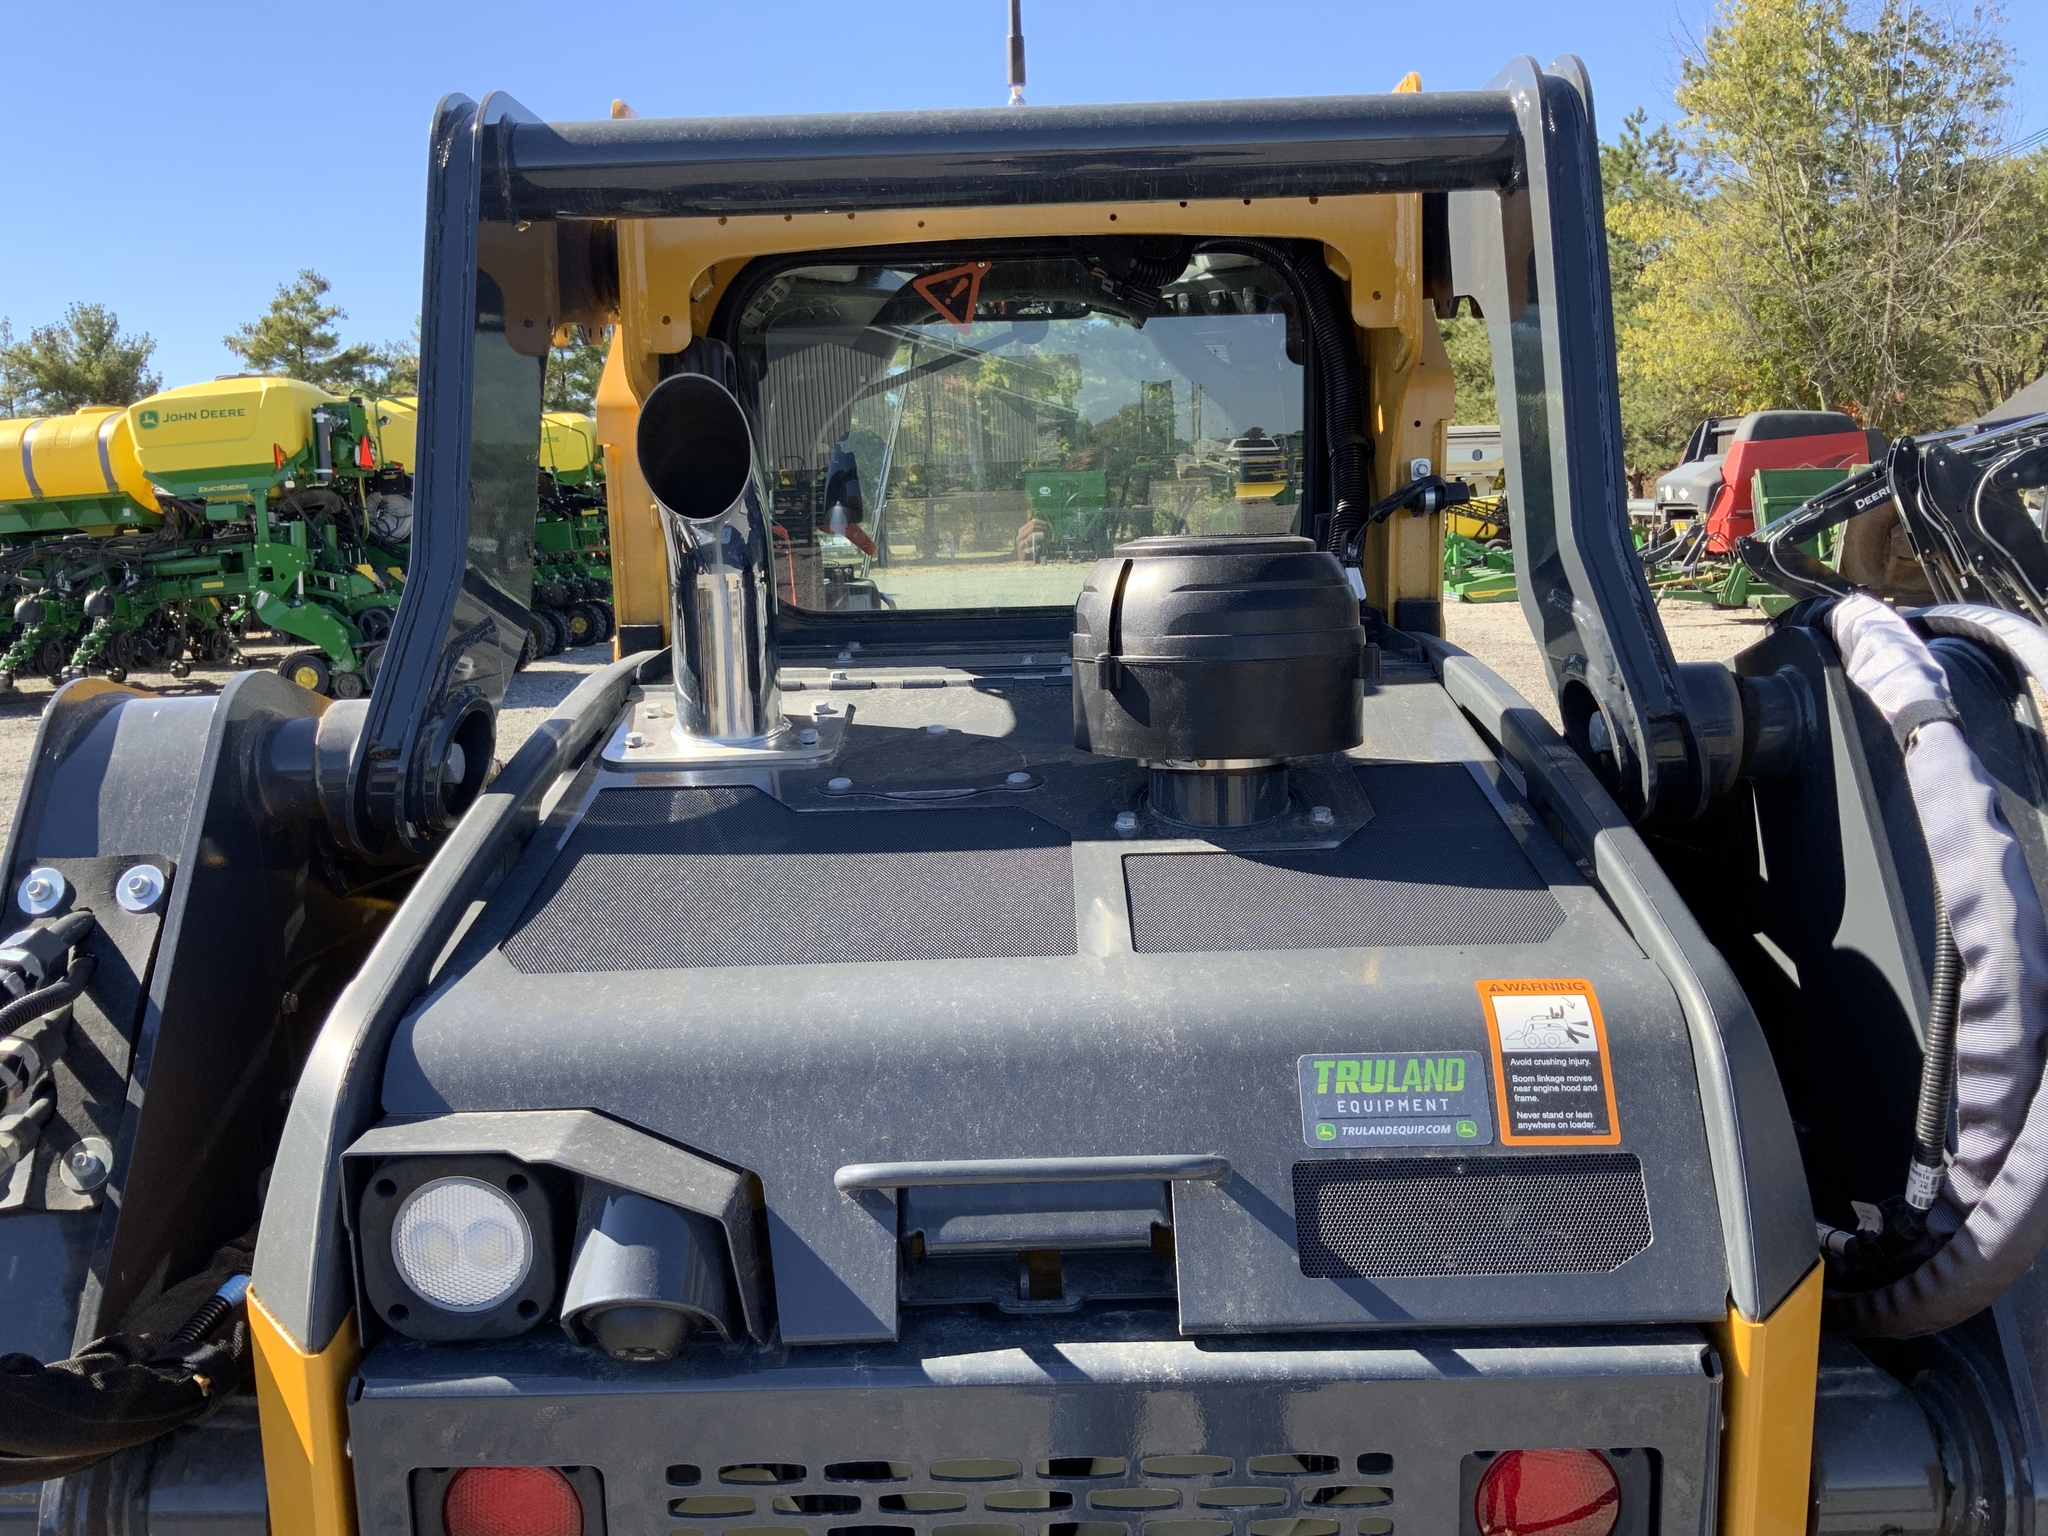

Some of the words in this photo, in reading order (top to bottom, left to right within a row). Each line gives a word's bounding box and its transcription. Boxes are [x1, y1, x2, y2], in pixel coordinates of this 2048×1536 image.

[162, 411, 197, 423] JOHN
[200, 408, 246, 420] DEERE
[1854, 485, 1891, 510] DEERE
[1503, 982, 1587, 992] WARNING
[1510, 1058, 1532, 1066] Avoid
[1533, 1058, 1567, 1067] crushing
[1568, 1058, 1592, 1067] injury.
[1313, 1058, 1466, 1095] TRULAND
[1512, 1075, 1536, 1083] Boom
[1537, 1074, 1565, 1084] linkage
[1532, 1085, 1560, 1093] engine
[1561, 1084, 1581, 1092] hood
[1582, 1084, 1598, 1092] and
[1514, 1094, 1540, 1102] frame.
[1337, 1098, 1449, 1113] EQUIPMENT
[1516, 1111, 1540, 1119] Never
[1541, 1111, 1564, 1119] stand
[1575, 1111, 1593, 1119] lean
[1341, 1124, 1451, 1136] TRULANDEQUIP.COM
[1517, 1121, 1556, 1130] anywhere
[1557, 1121, 1568, 1129] on
[1569, 1121, 1597, 1129] loader.
